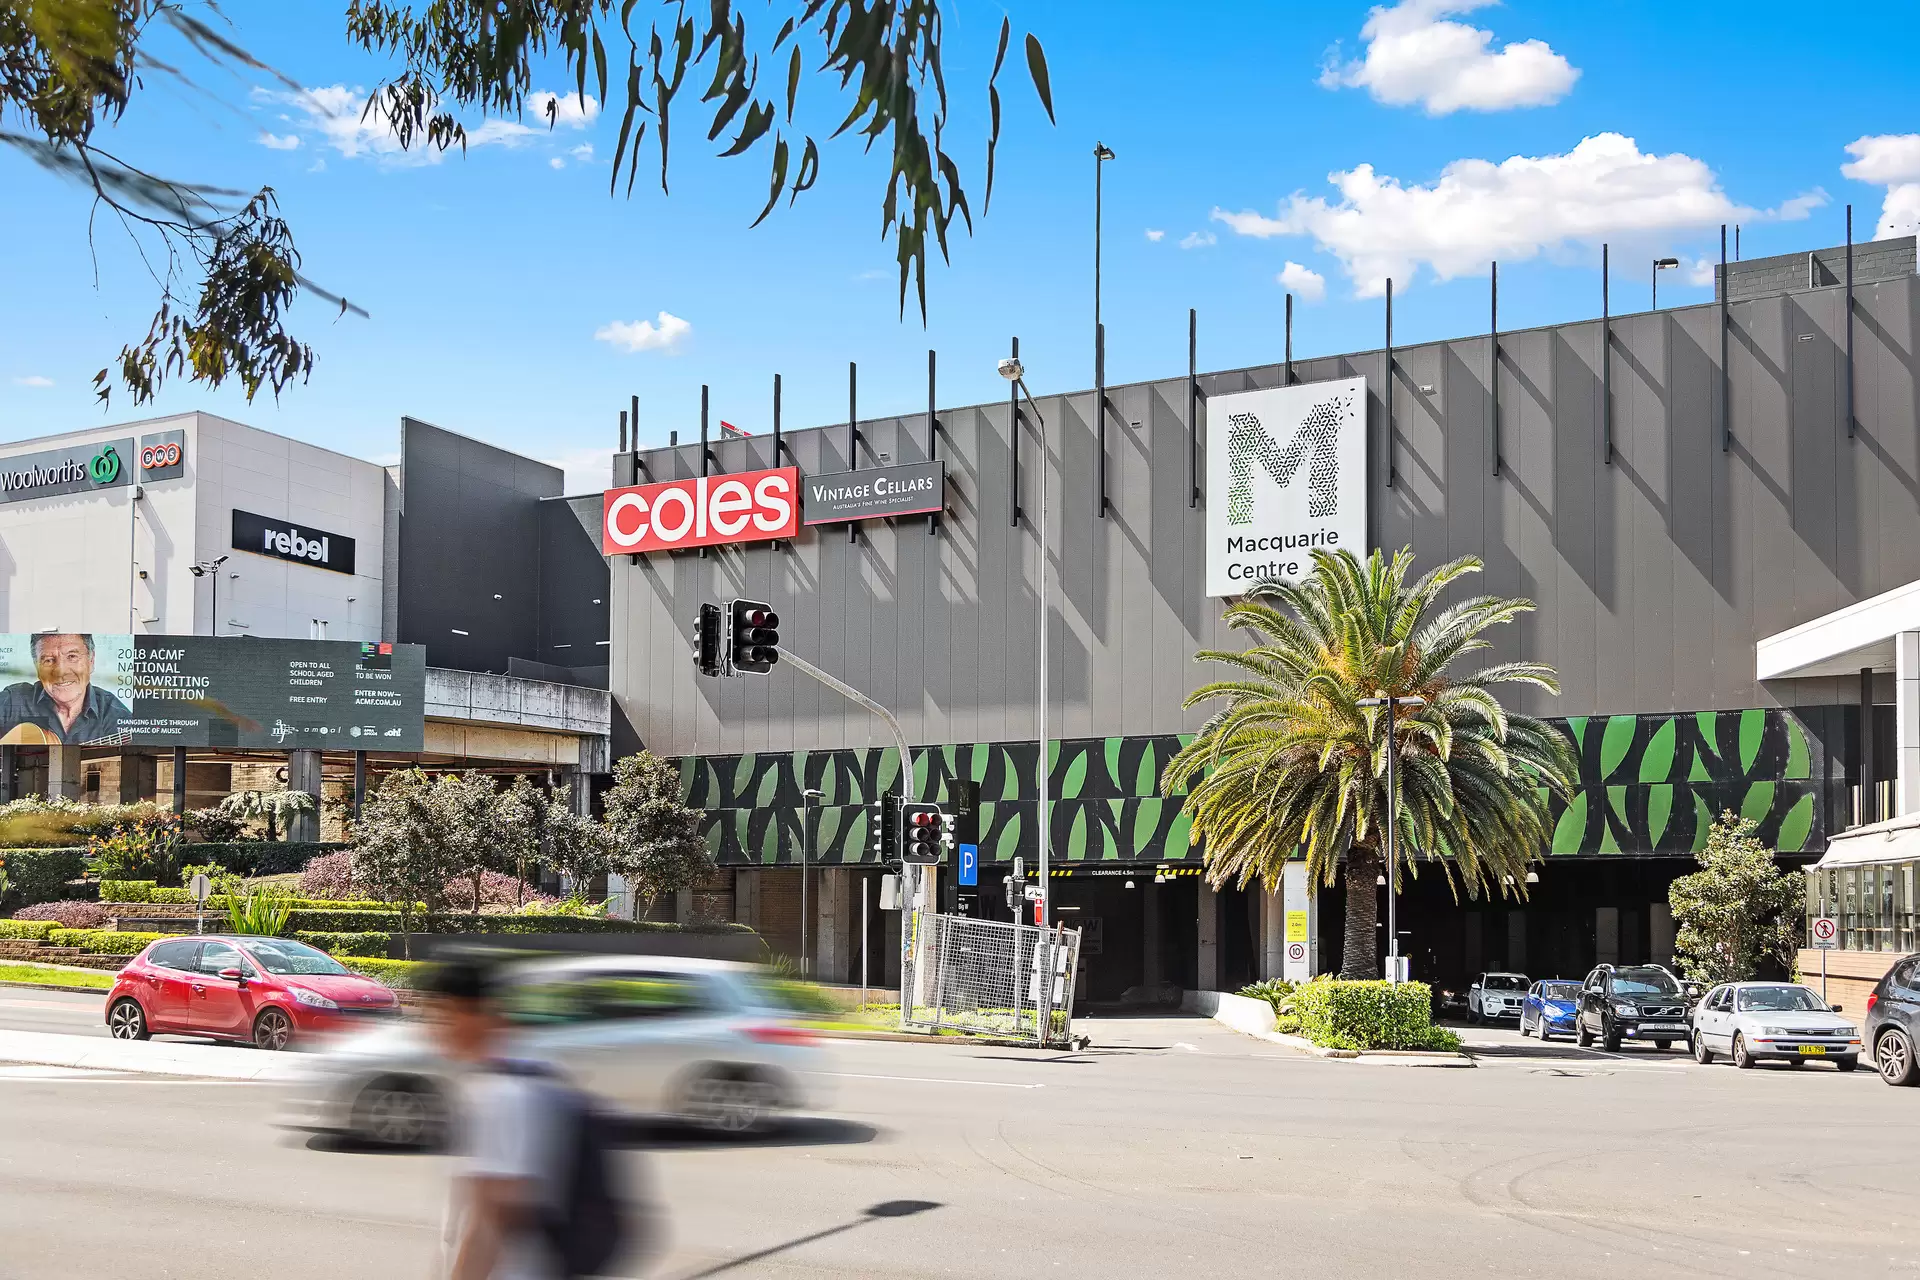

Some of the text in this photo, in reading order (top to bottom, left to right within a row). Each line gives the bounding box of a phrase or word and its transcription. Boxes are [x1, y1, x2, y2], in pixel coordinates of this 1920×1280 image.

[0, 459, 85, 491] Woolworths
[812, 477, 933, 502] VINTAGE CELLARS
[607, 475, 791, 547] coles
[264, 528, 329, 563] rebel
[1227, 528, 1339, 553] Macquarie
[1227, 560, 1299, 580] Centre
[117, 648, 186, 660] 2018 ACMF
[117, 662, 181, 674] NATIONAL
[117, 675, 210, 688] SONGWRITING
[117, 688, 205, 700] COMPETITION
[306, 696, 328, 704] ENTRY
[354, 689, 376, 697] ENTER
[964, 851, 974, 878] P
[1292, 947, 1300, 955] 10
